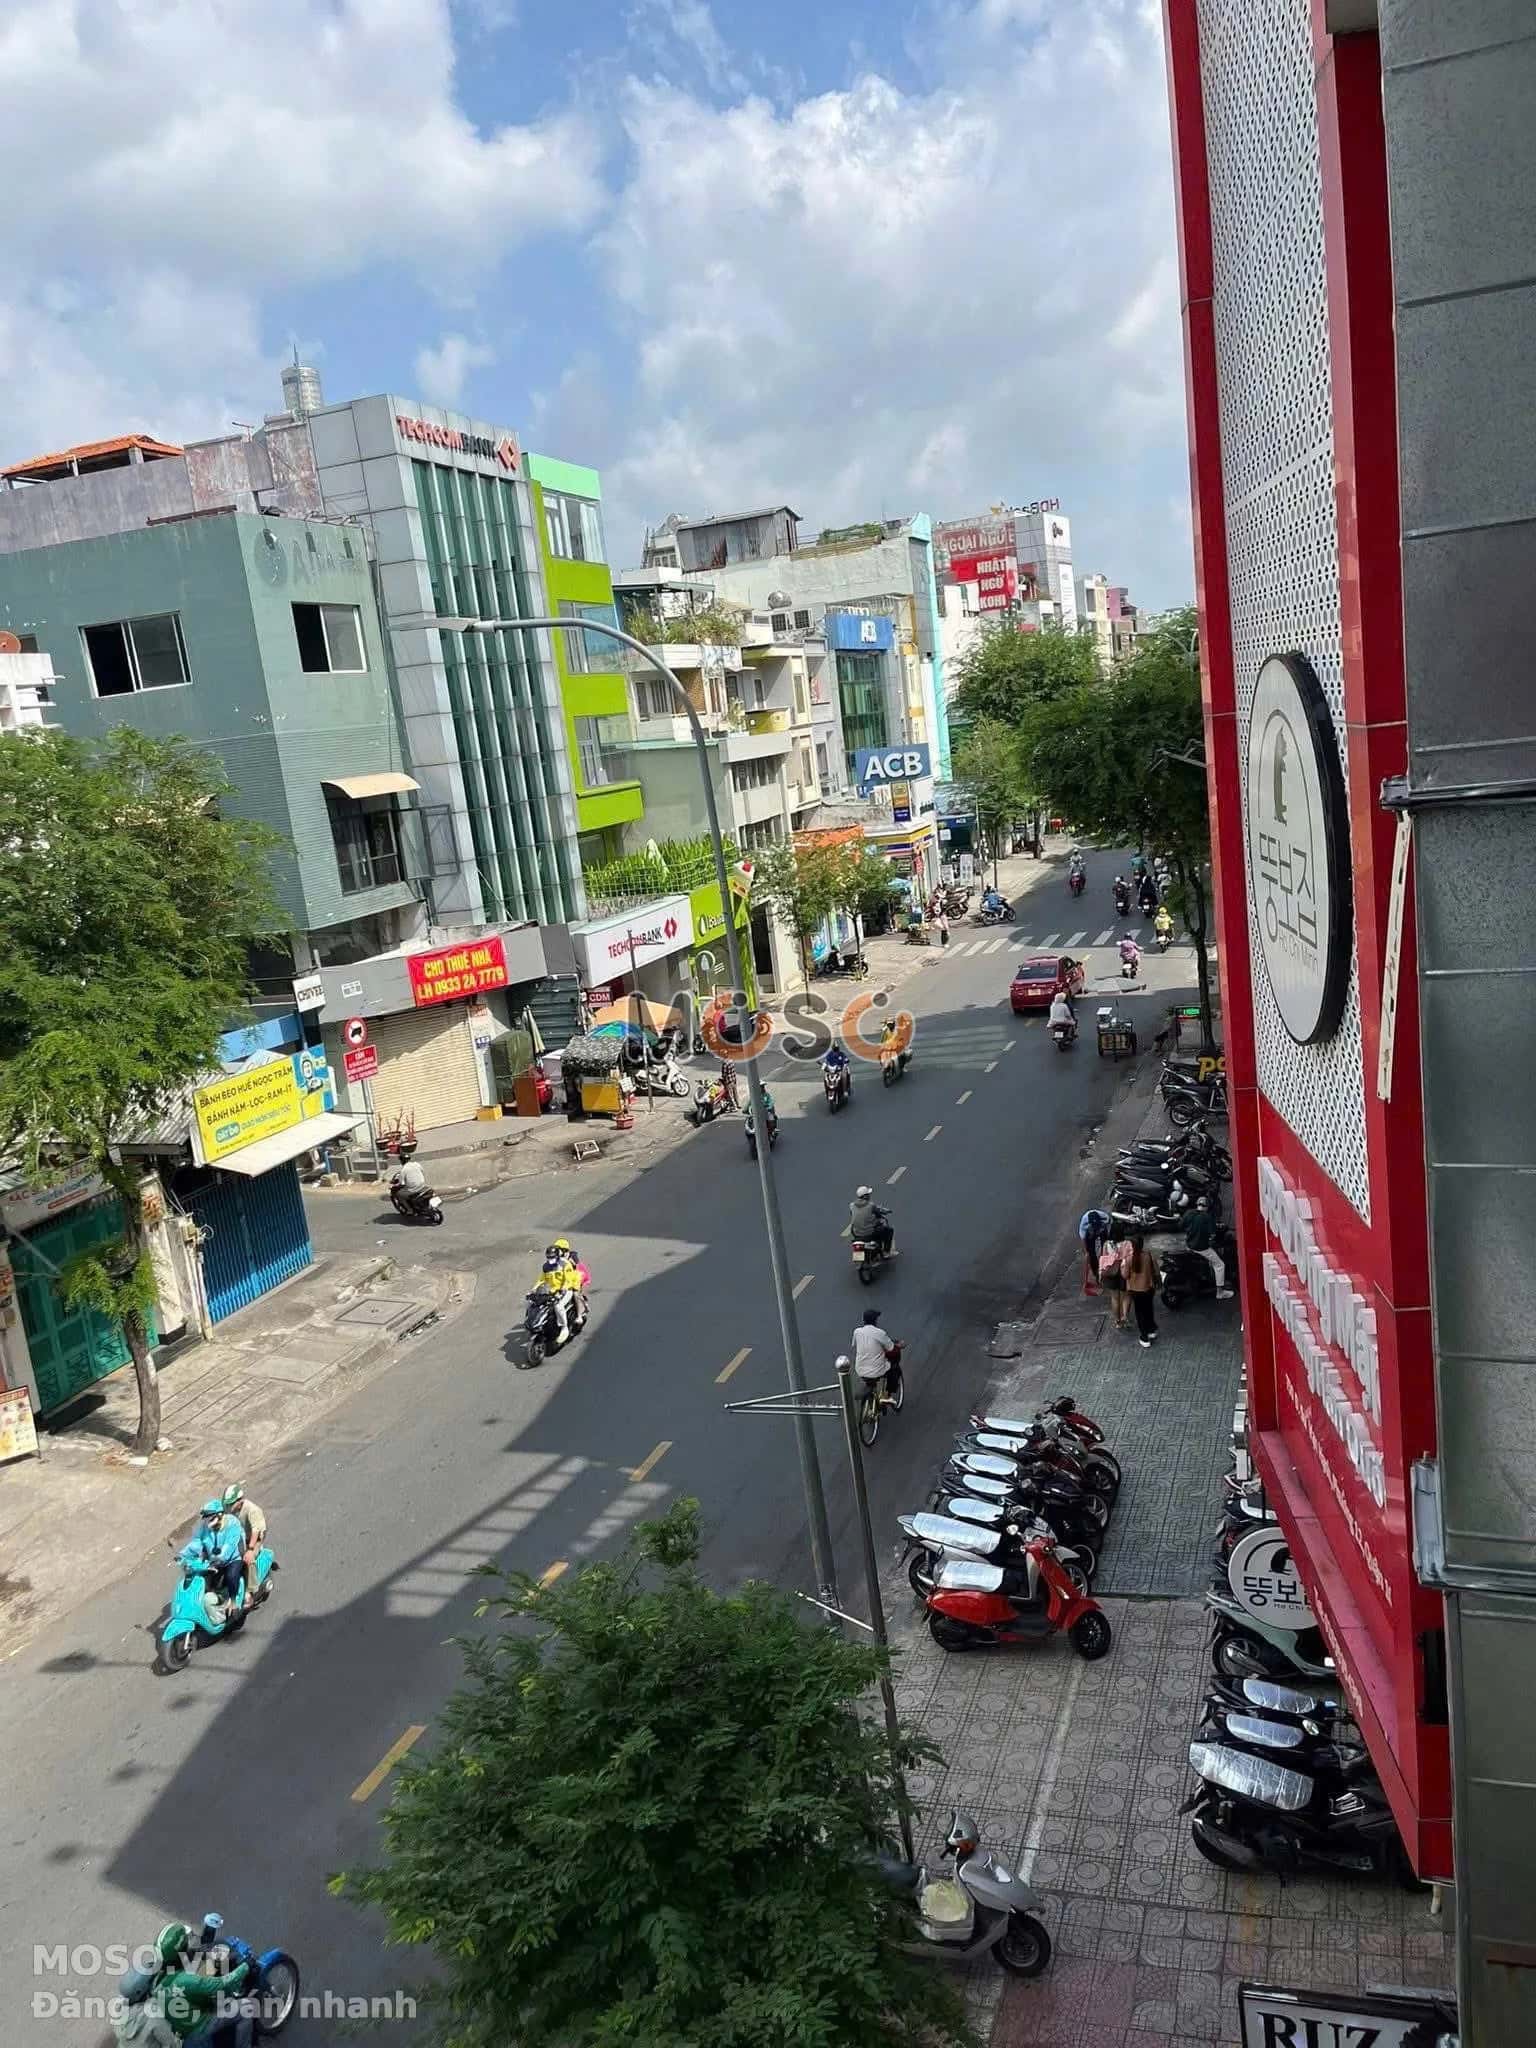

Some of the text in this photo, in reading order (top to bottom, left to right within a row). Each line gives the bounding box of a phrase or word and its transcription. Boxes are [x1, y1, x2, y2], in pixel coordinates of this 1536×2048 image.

[396, 415, 498, 461] TECHCOMBANK
[864, 751, 924, 781] ACB
[1258, 831, 1319, 950] 뚱보집
[423, 959, 446, 978] CHO
[446, 950, 471, 973] THUÊ
[417, 982, 434, 999] LH
[434, 975, 462, 995] 0933
[461, 973, 477, 989] 24
[589, 993, 612, 1002] CDM
